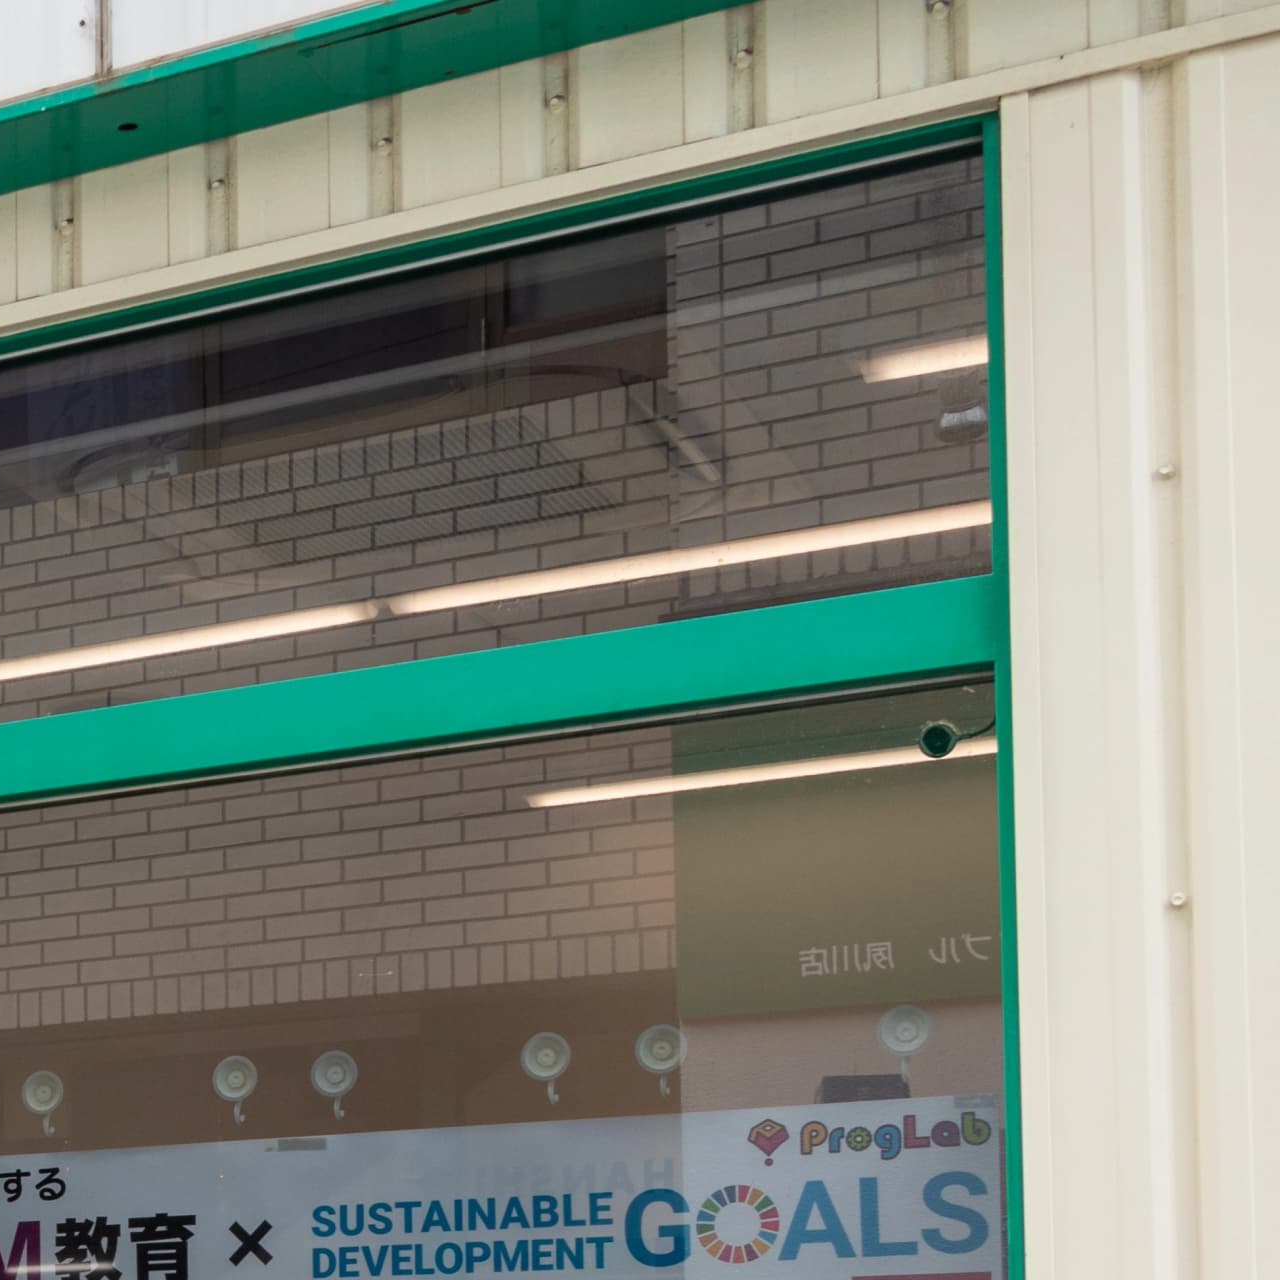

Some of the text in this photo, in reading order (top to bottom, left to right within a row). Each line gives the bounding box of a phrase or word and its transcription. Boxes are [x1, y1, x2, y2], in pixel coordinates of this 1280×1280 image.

[800, 1110, 992, 1161] ProgLab
[311, 1191, 614, 1237] SUSTAINABLE
[624, 1171, 990, 1267] GOALS
[312, 1236, 614, 1280] DEVELOPMENT
